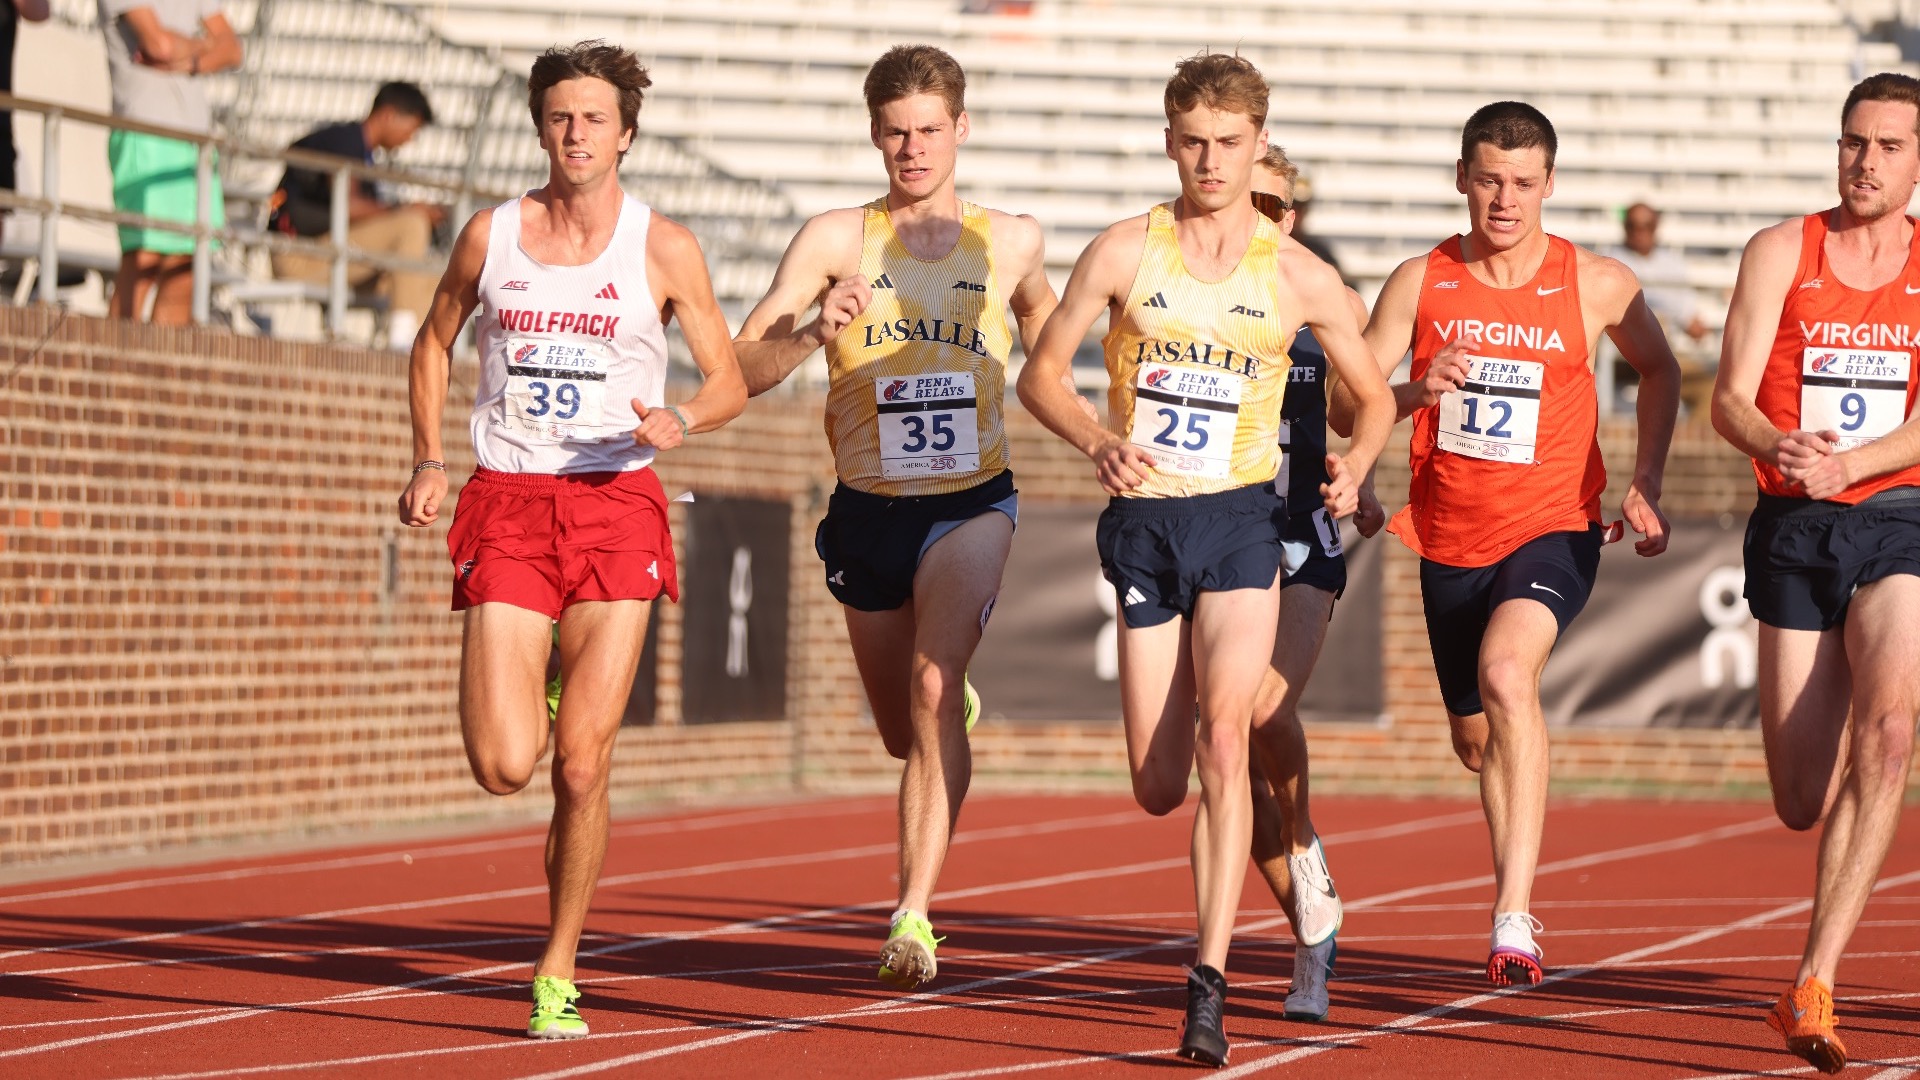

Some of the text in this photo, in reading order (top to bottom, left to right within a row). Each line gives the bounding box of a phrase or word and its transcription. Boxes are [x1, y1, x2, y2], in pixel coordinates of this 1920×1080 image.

[501, 280, 531, 291] ACC
[1434, 280, 1460, 289] ACC
[498, 308, 620, 338] WOLFPACK
[1433, 319, 1566, 352] VIRGINIA
[548, 345, 586, 357] PENN
[544, 356, 597, 368] RELAYS
[1847, 354, 1887, 366] PENN
[1481, 362, 1520, 374] PENN
[1844, 365, 1898, 377] RELAYS
[916, 377, 953, 388] PENN
[1180, 372, 1220, 386] PENN
[1478, 372, 1532, 385] RELAYS
[914, 386, 965, 398] RELAYS
[1176, 382, 1231, 398] RELAYS
[526, 381, 580, 419] 39
[1460, 397, 1513, 439] 12
[1839, 392, 1867, 431] 9
[901, 413, 956, 453] 35
[1153, 408, 1211, 451] 25
[930, 456, 957, 471] 250
